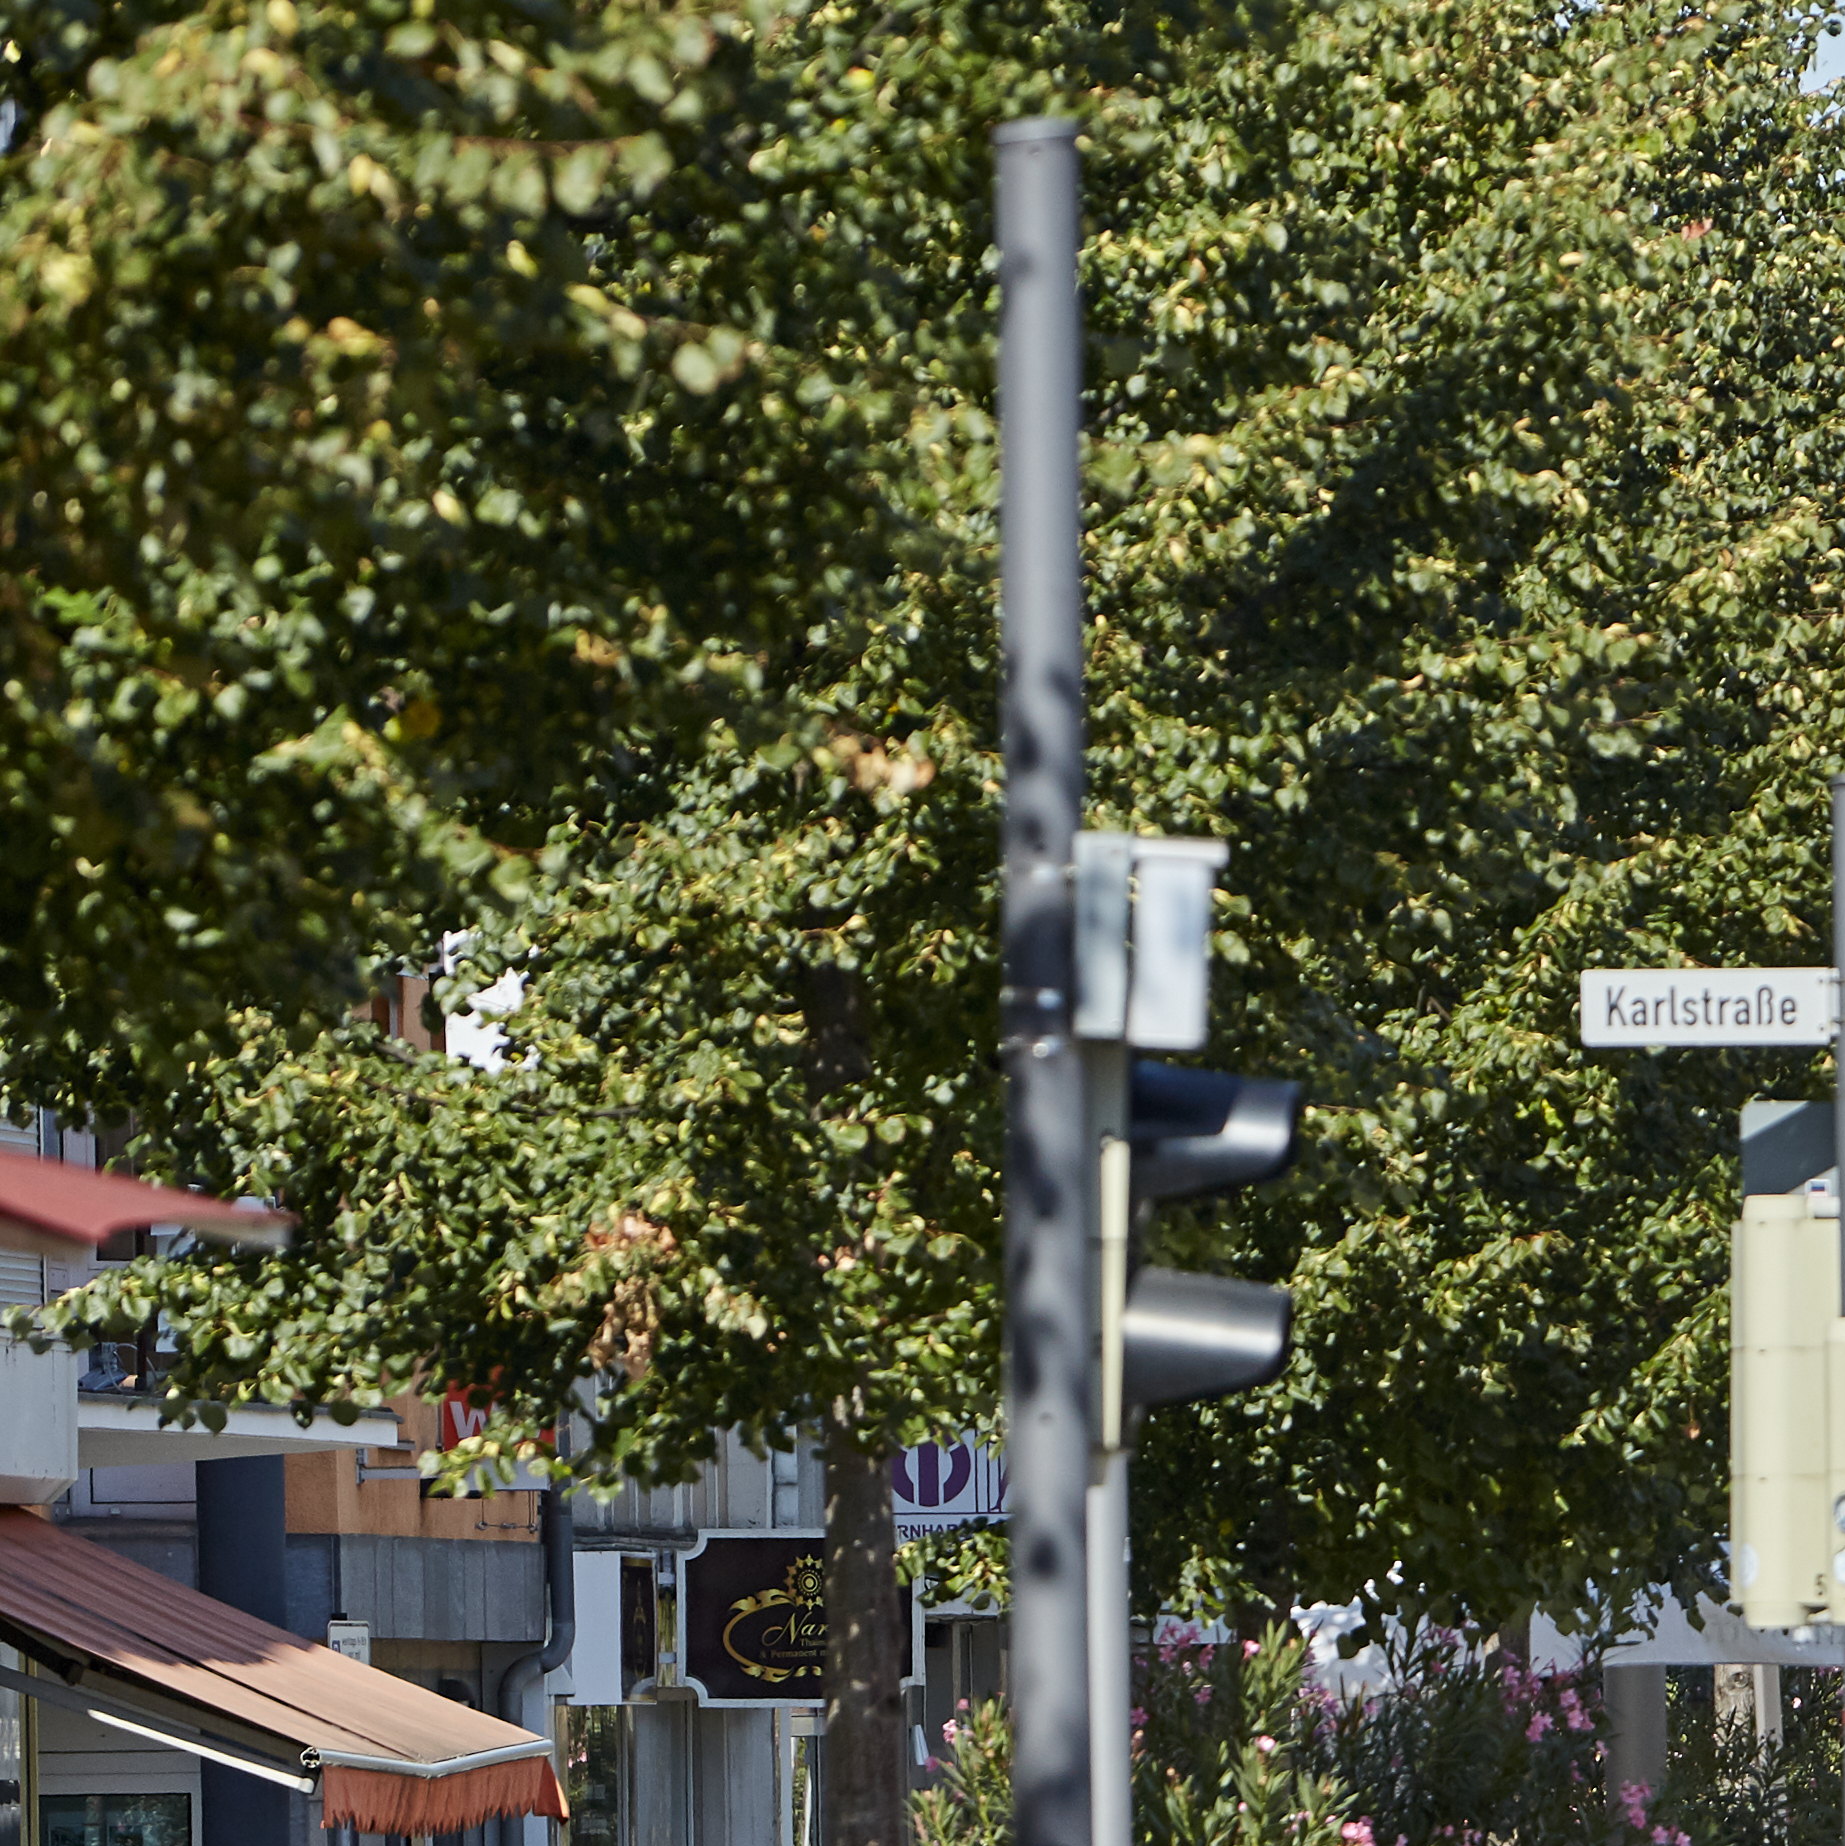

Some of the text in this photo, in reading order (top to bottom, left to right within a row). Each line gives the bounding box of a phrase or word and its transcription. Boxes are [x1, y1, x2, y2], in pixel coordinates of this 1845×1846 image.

[1606, 985, 1798, 1026] Karlstraße
[761, 1610, 829, 1646] Nar
[800, 1637, 827, 1647] Thaim
